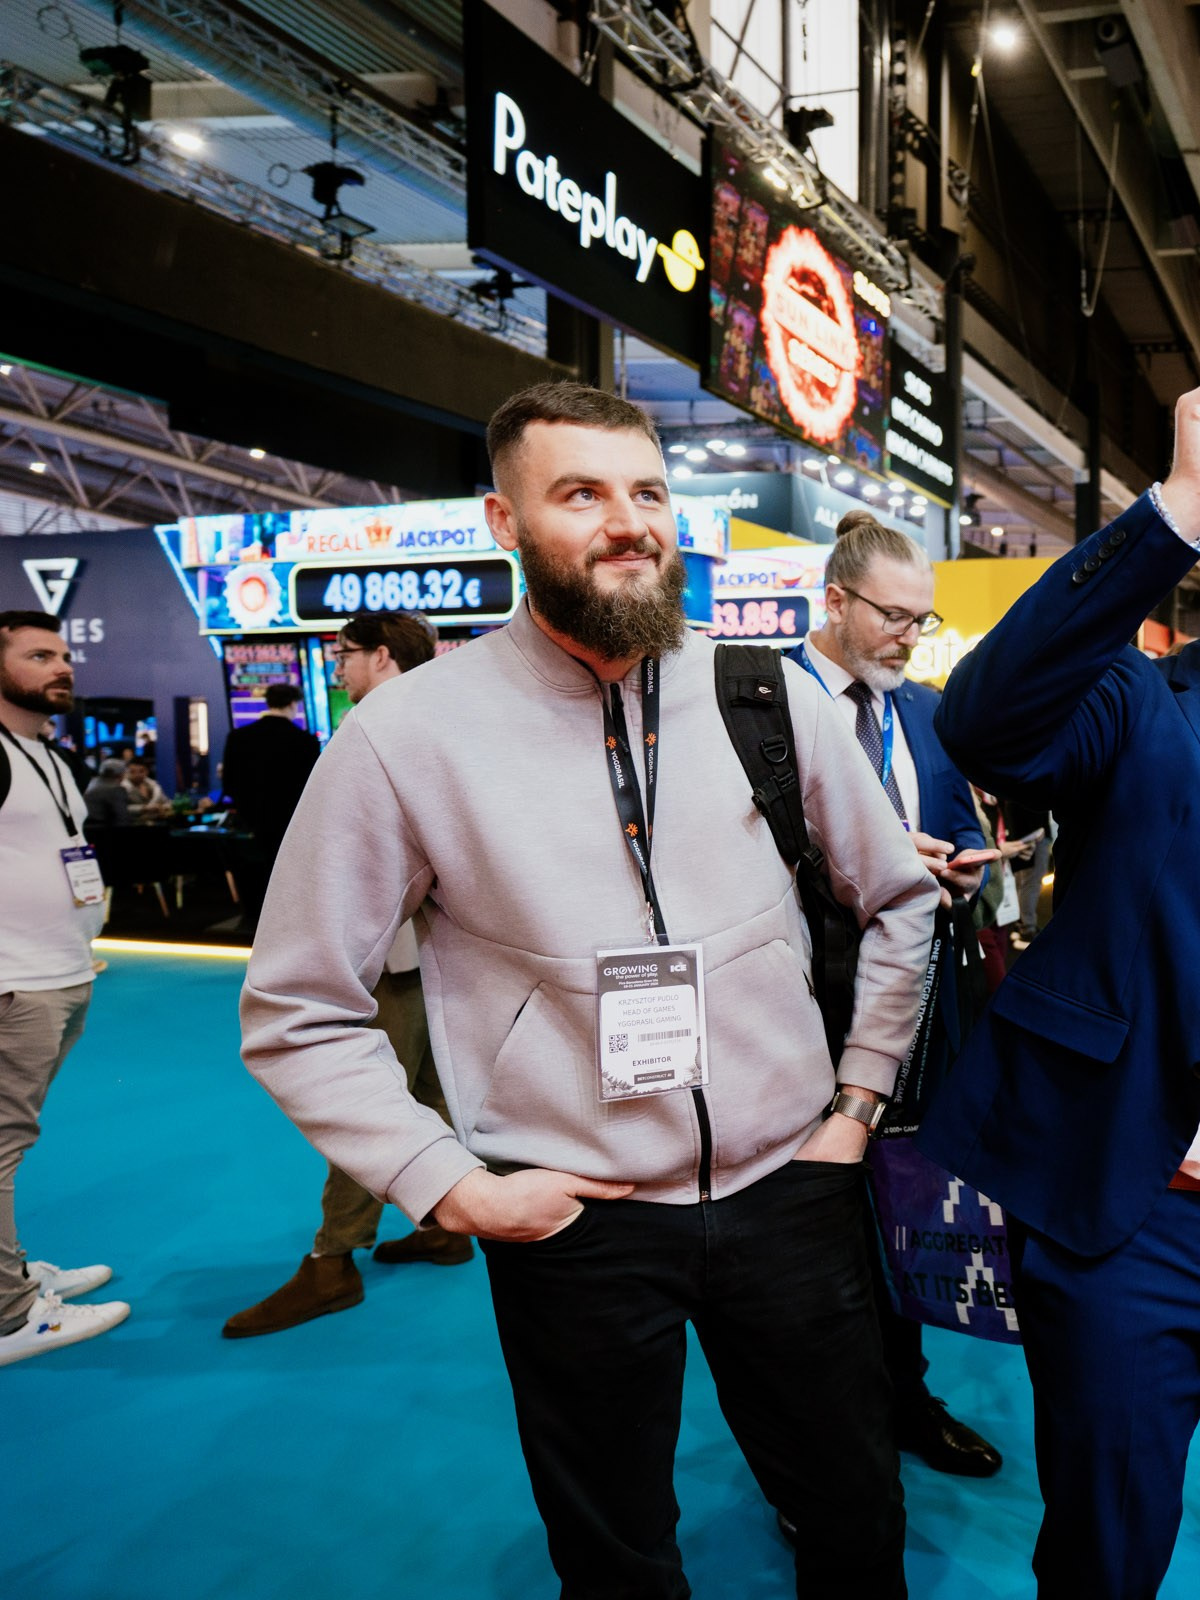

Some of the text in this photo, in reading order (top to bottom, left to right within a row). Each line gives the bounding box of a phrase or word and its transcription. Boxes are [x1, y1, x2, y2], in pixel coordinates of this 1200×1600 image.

[494, 92, 658, 283] Pateplay
[307, 528, 477, 553] REGAL JACKPOT
[717, 572, 778, 586] ACKPOT
[611, 750, 625, 788] YGGDRASIL
[931, 939, 941, 962] ONE
[604, 964, 658, 976] GROWING
[670, 964, 687, 973] ICE
[618, 997, 656, 1006] KRZYSZTOF
[653, 1005, 676, 1013] GAMES
[915, 963, 937, 1033] INTEGRATION
[618, 1015, 682, 1027] YGGDRASIL GAMING
[632, 1056, 672, 1067] EXHIBITOR
[900, 1051, 914, 1079] EVERY
[893, 1078, 907, 1104] GAME
[911, 1229, 1006, 1256] AGGREGAT
[903, 1271, 1012, 1308] AT ITS BE
